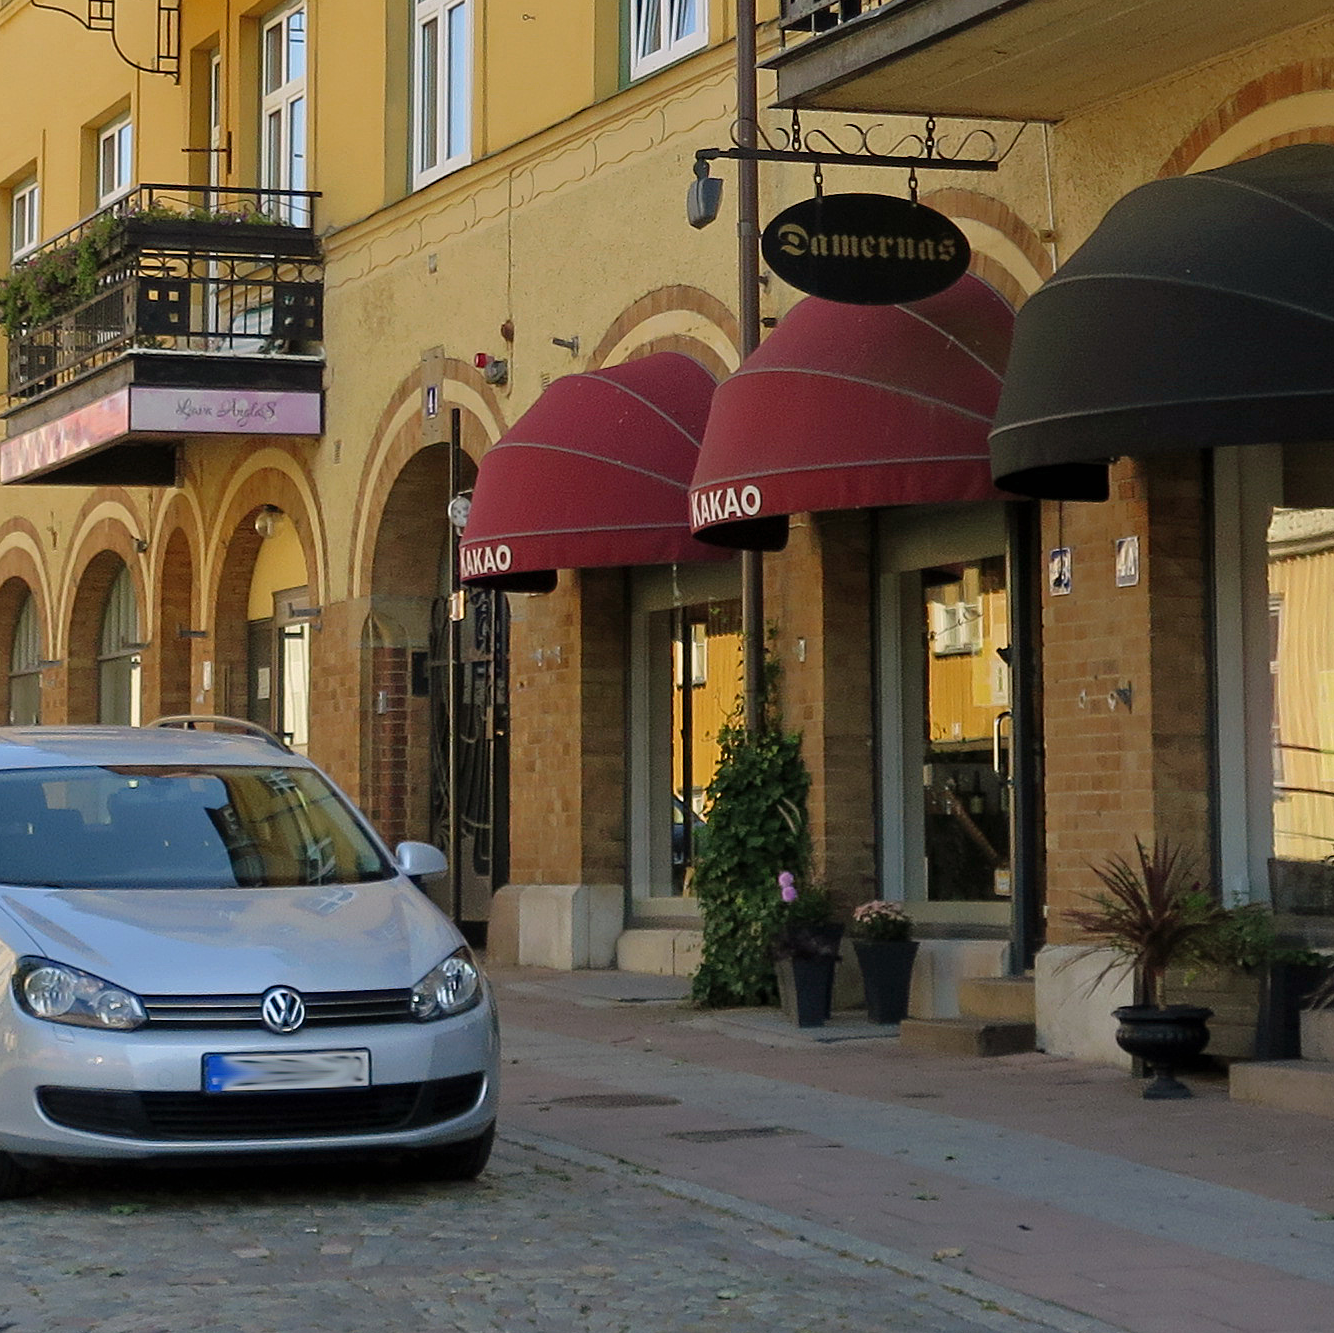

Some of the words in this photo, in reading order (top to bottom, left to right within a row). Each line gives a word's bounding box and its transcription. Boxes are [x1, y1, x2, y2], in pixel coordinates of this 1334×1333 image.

[777, 222, 957, 262] Damernas
[690, 484, 762, 528] KAKAO
[460, 544, 512, 578] KAKAO
